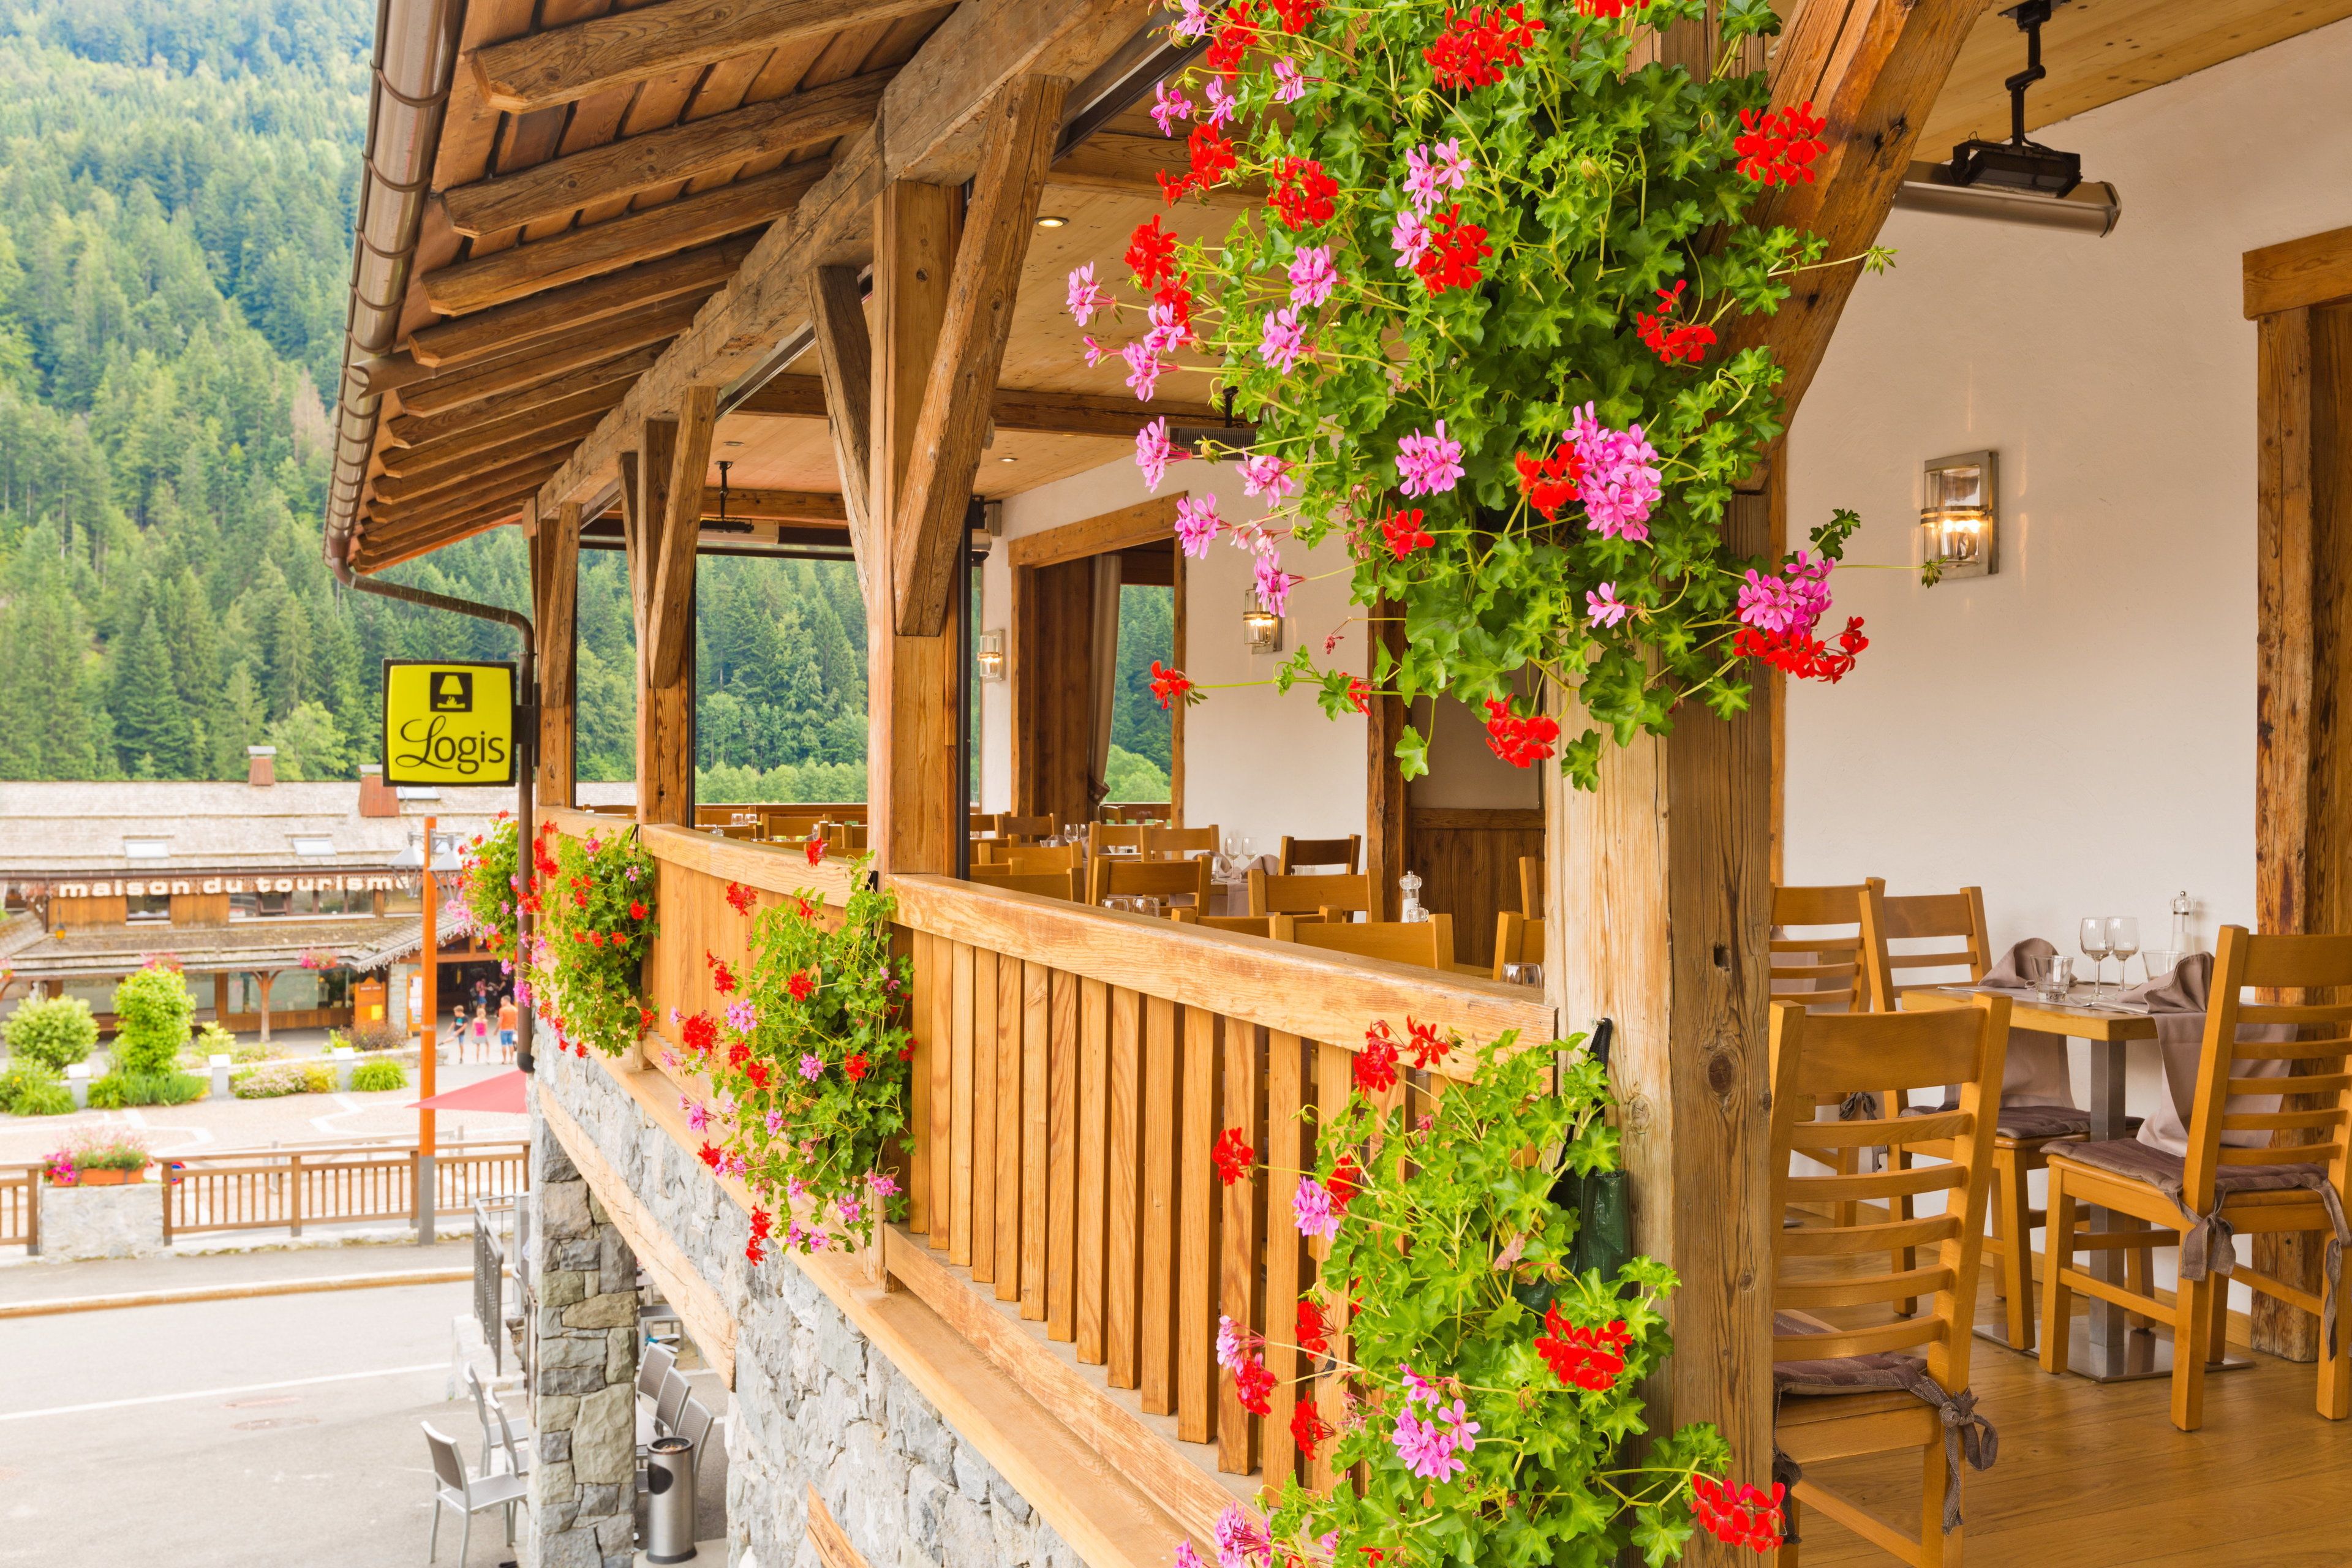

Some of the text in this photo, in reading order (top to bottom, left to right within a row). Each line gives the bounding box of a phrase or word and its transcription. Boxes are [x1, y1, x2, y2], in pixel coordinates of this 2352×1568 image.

[396, 715, 505, 775] Logis
[59, 875, 410, 898] maison du tourisme
